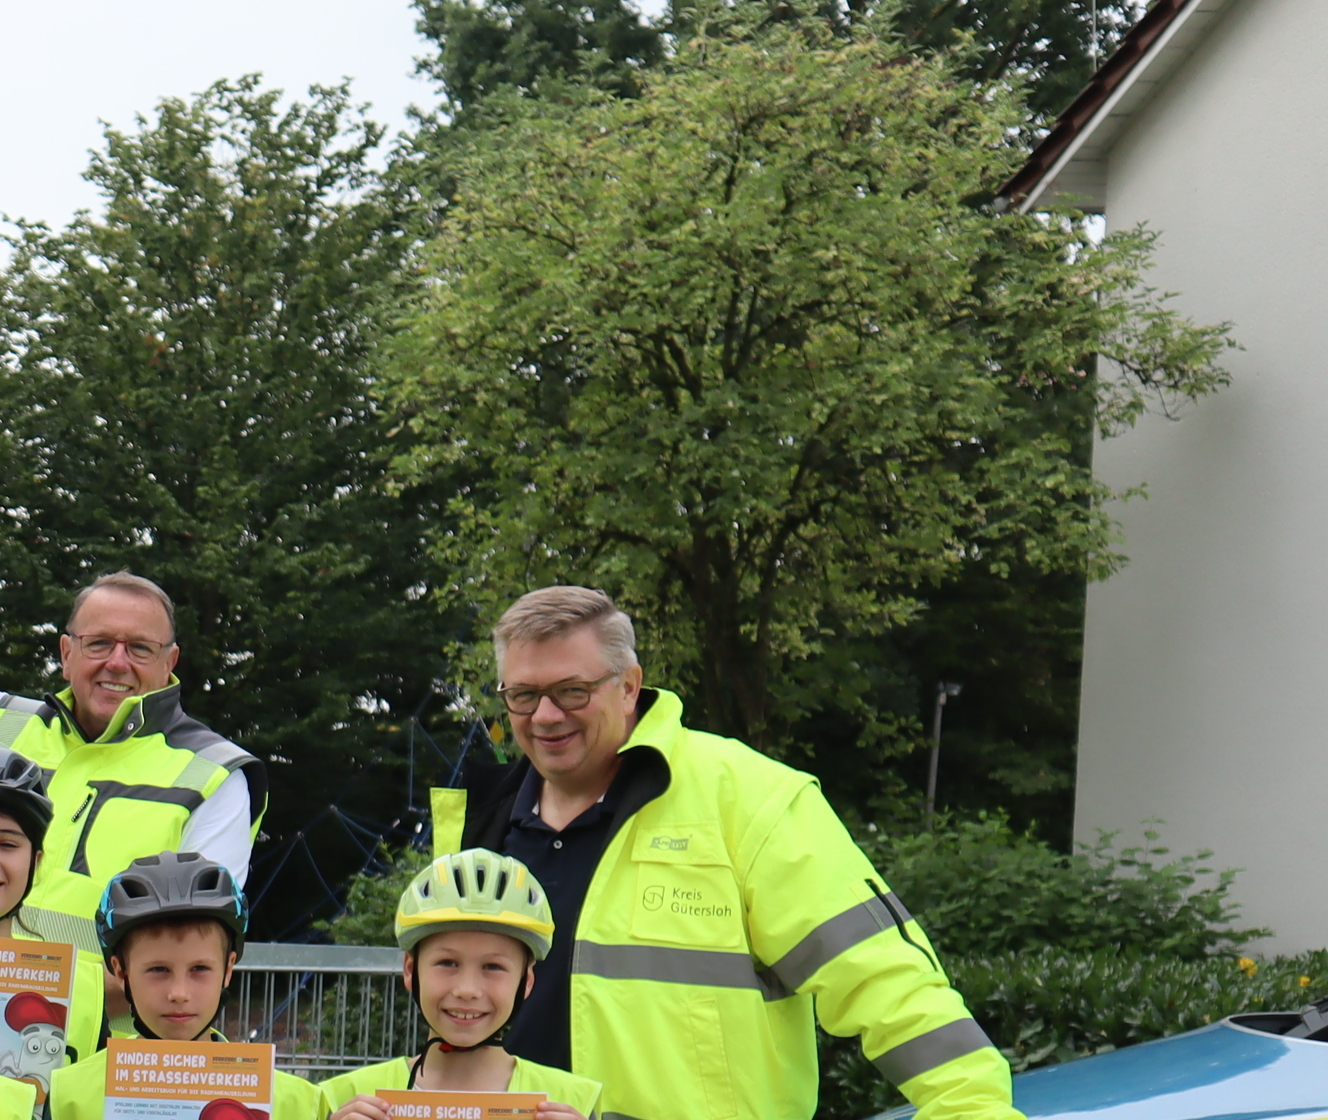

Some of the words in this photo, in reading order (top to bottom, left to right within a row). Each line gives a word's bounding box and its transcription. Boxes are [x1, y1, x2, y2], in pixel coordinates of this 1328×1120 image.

[672, 887, 702, 901] Kreis
[670, 902, 732, 917] Gütersloh
[116, 1051, 159, 1066] KINDER
[162, 1053, 207, 1068] SICHER
[115, 1069, 129, 1081] IM
[132, 1069, 259, 1087] STRASSENVERKEHR
[387, 1103, 432, 1118] KINDER
[435, 1105, 482, 1120] SICHER
